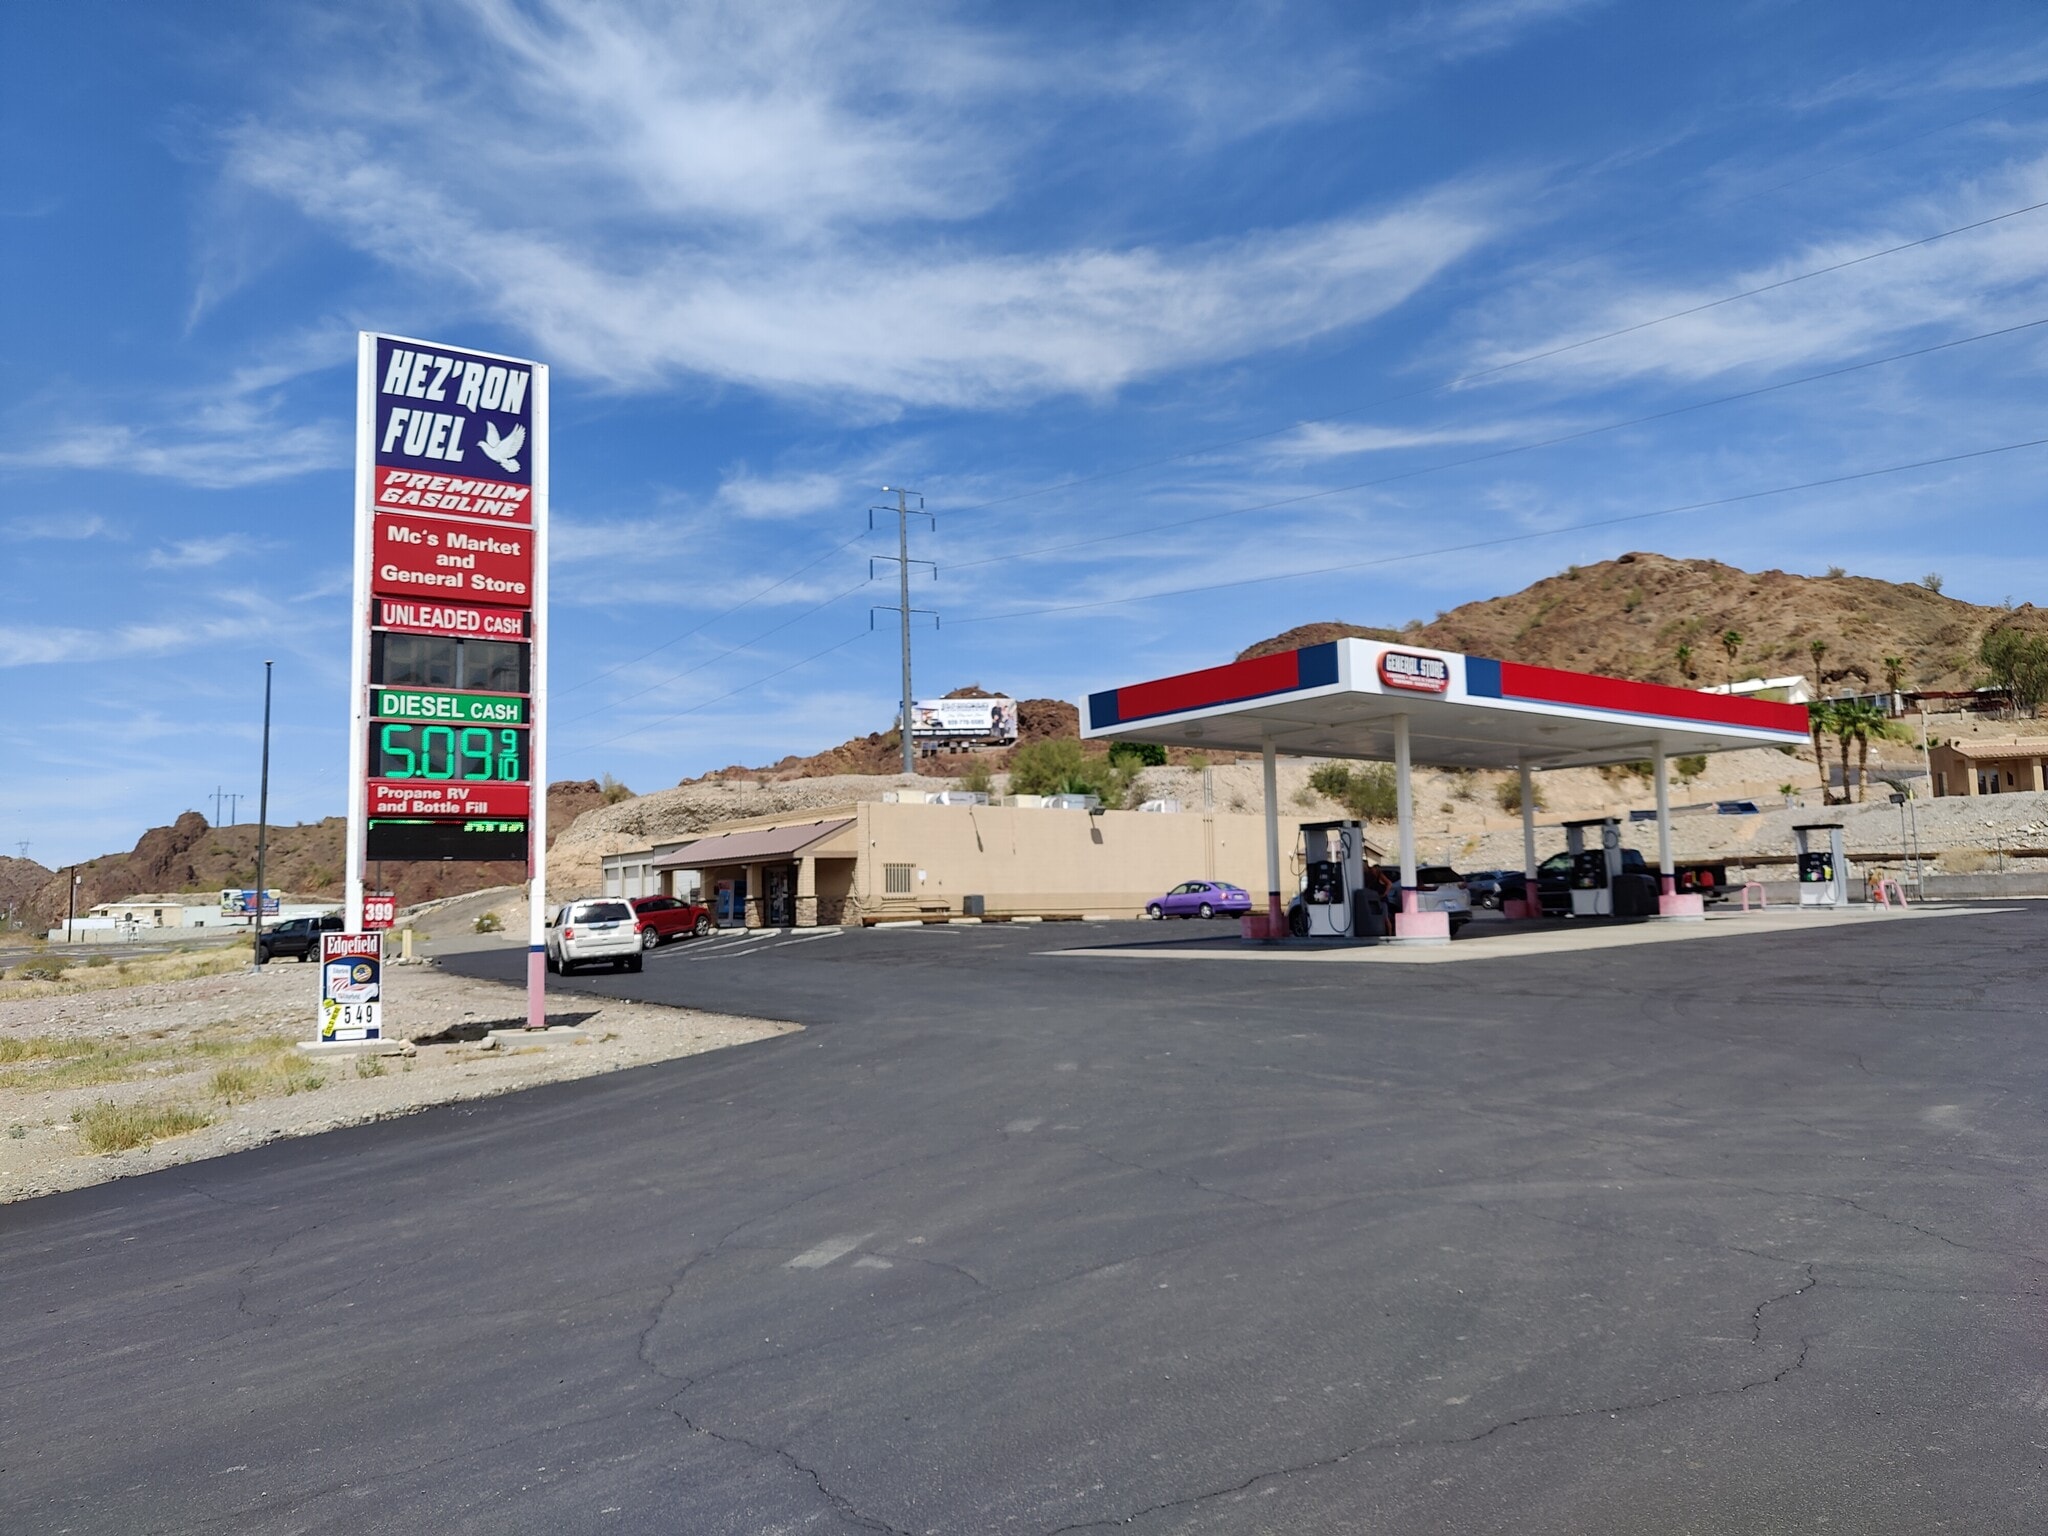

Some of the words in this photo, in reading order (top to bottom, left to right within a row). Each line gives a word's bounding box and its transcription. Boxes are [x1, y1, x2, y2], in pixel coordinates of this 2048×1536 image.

[382, 349, 530, 415] HEZ'RON
[381, 407, 466, 462] FUEL
[384, 470, 530, 501] PREMIUM
[380, 487, 520, 517] GASOLINE
[387, 525, 439, 546] Mc's
[447, 532, 521, 556] Market
[436, 554, 475, 569] and
[380, 564, 463, 587] General
[471, 574, 526, 594] Store
[383, 603, 480, 631] UNLEADED
[484, 615, 521, 634] CASH
[383, 694, 465, 718] DIESEL
[470, 703, 518, 720] CASH
[377, 786, 442, 800] Propane
[447, 788, 470, 800] RV
[377, 801, 407, 813] and
[412, 800, 460, 813] Bottle
[465, 802, 488, 814] Fill
[365, 902, 394, 921] 399
[327, 935, 378, 956] Edgefield
